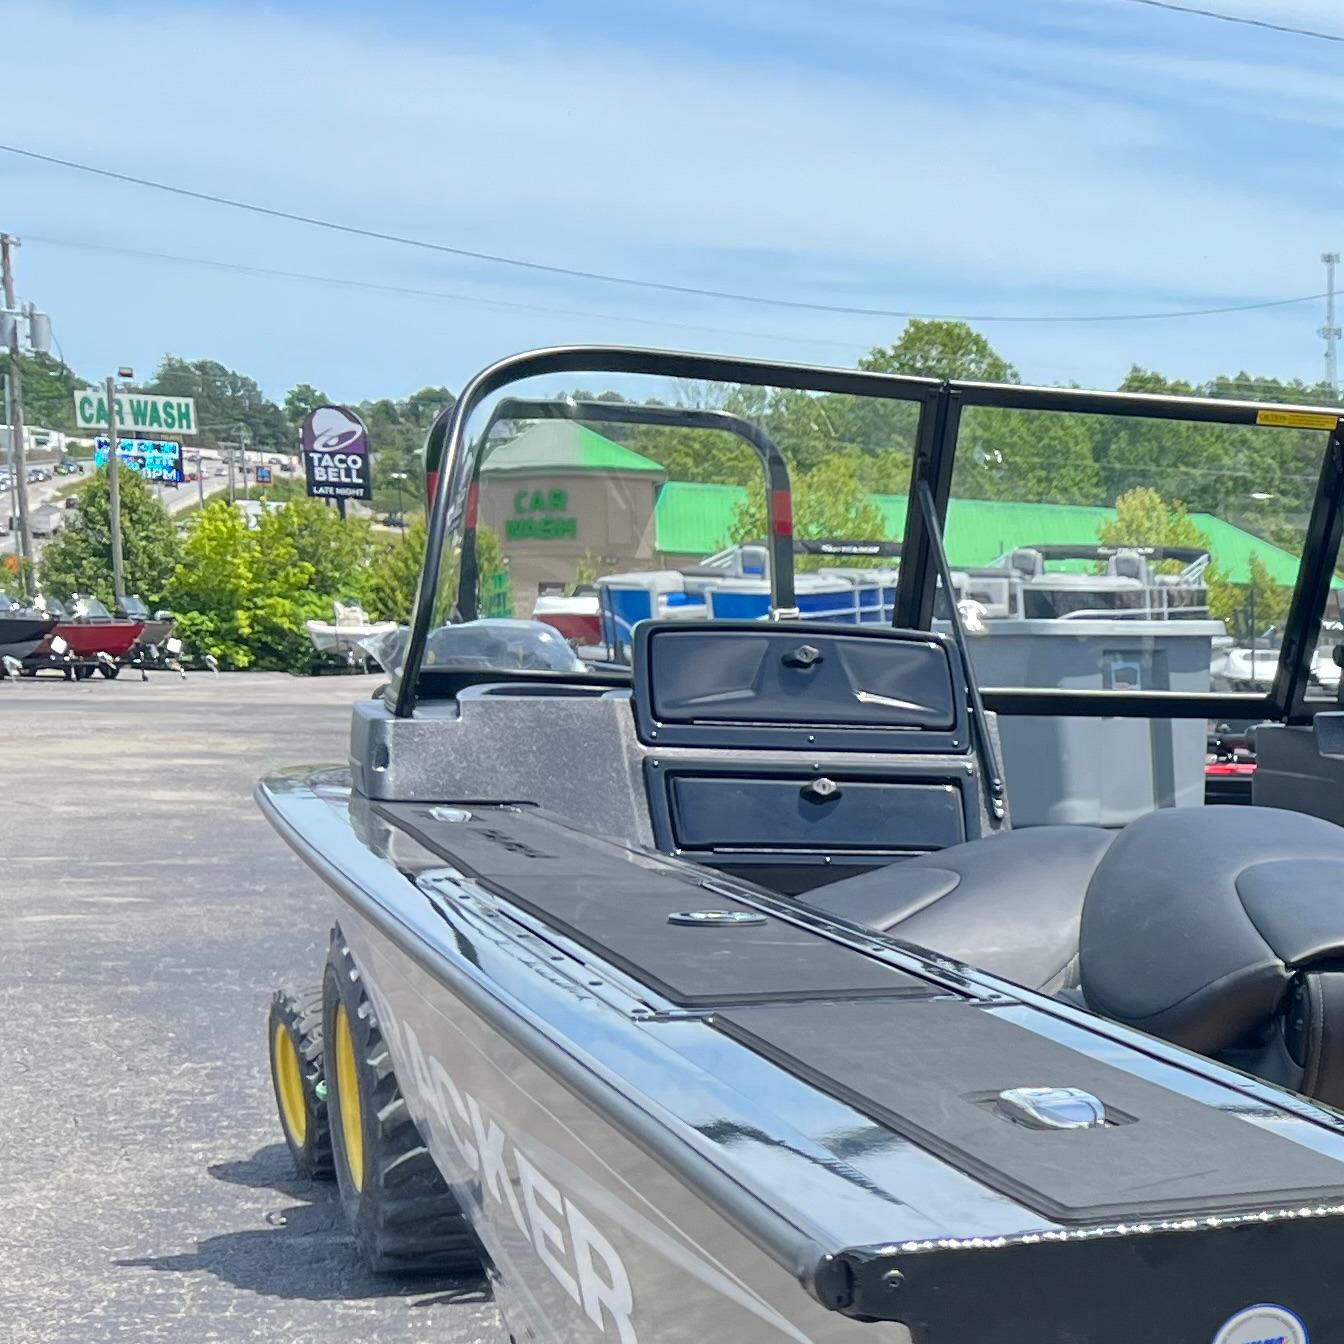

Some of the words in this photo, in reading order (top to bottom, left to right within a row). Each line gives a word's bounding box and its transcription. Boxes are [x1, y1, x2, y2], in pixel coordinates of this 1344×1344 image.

[79, 396, 125, 425] CAR
[130, 401, 192, 430] WASH
[309, 452, 363, 470] TACO
[313, 467, 363, 484] BELL
